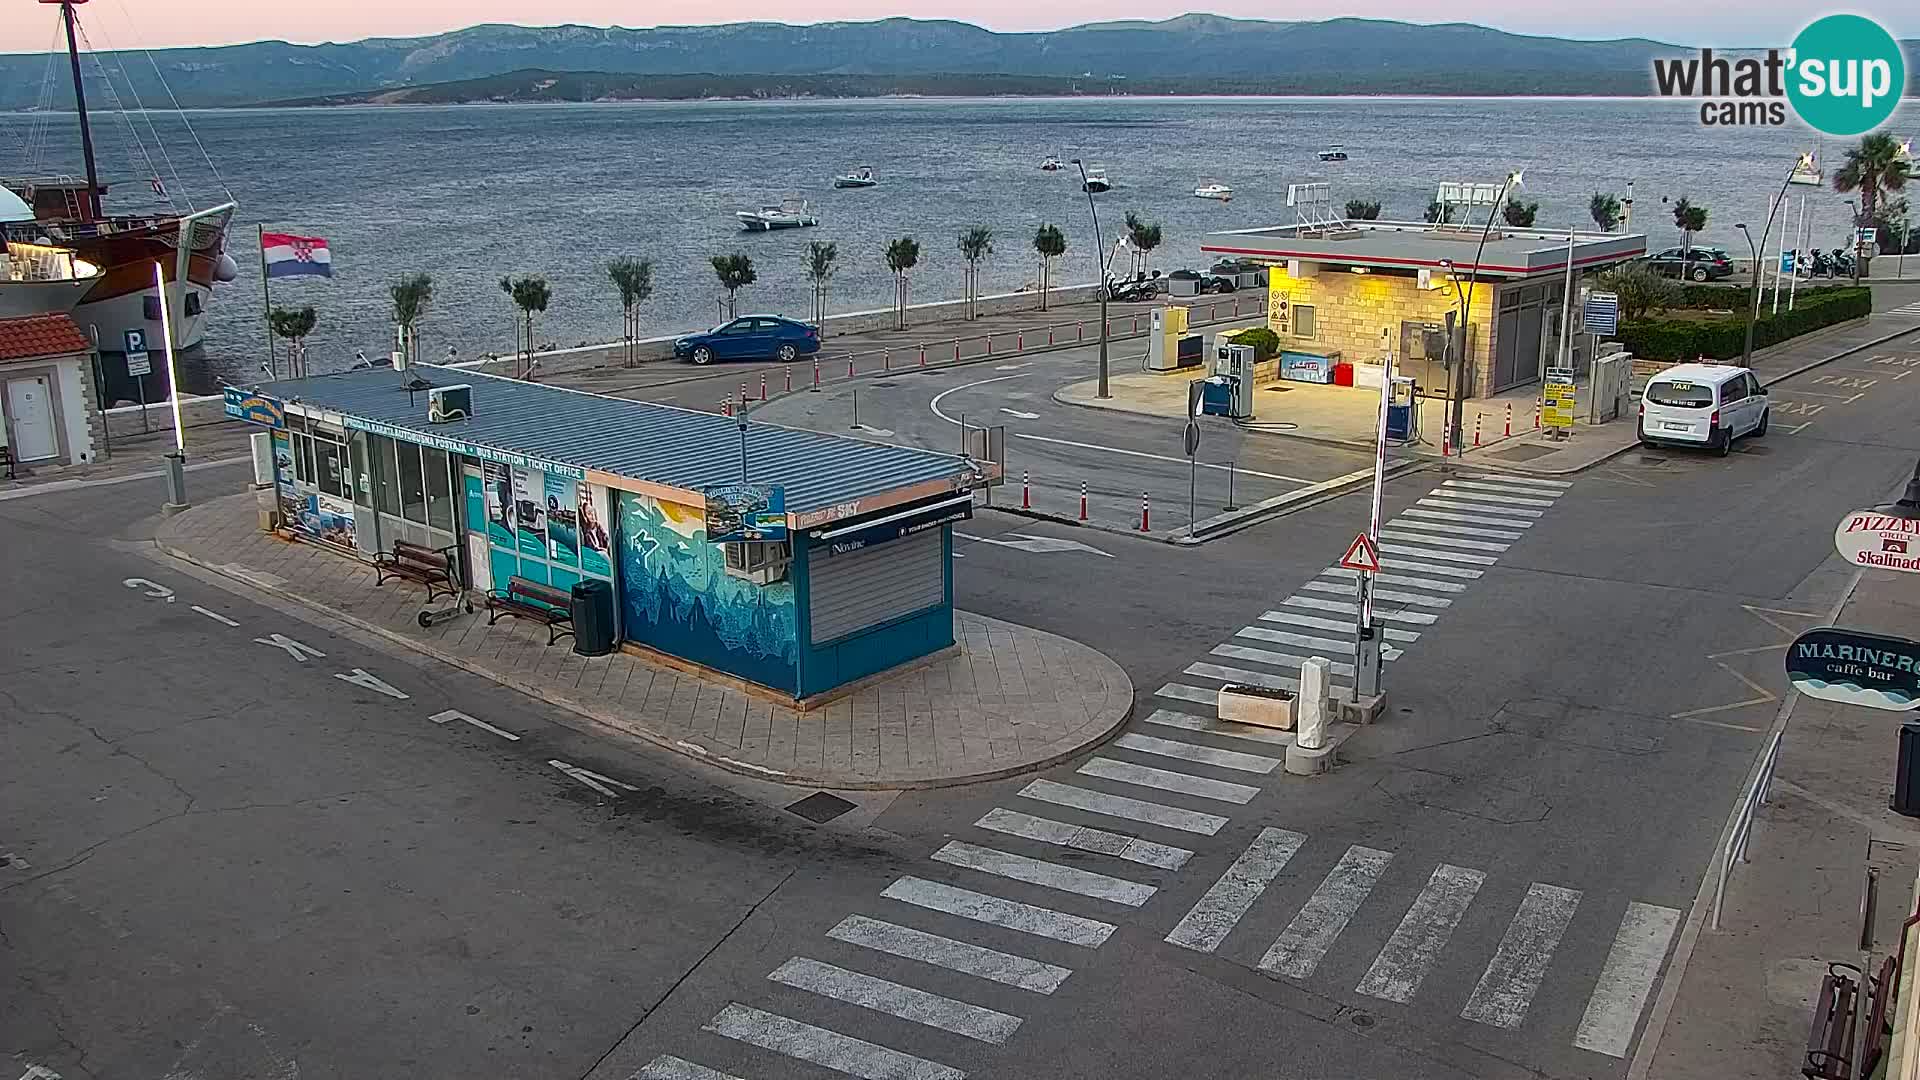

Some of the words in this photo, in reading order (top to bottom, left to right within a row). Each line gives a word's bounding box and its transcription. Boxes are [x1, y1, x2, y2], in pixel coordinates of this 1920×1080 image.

[129, 332, 142, 351] P
[1672, 383, 1691, 391] TAXI
[435, 437, 467, 453] POSTAJA
[476, 447, 492, 459] BUS
[492, 450, 525, 466] STATION
[526, 458, 553, 473] TICKET
[554, 464, 581, 479] OFFICE
[1846, 516, 1920, 534] PIZZE
[831, 540, 865, 556] Novine
[1826, 663, 1863, 676] caffe
[1868, 666, 1895, 680] bar
